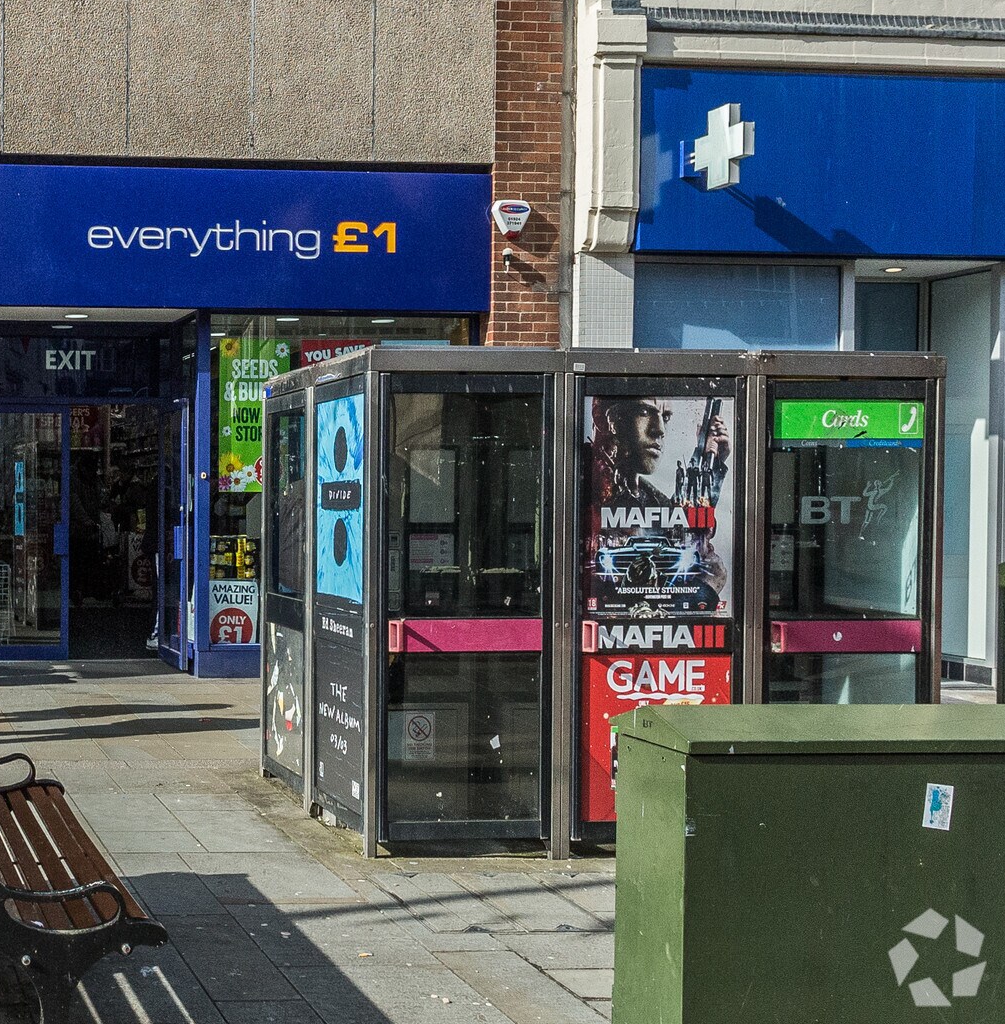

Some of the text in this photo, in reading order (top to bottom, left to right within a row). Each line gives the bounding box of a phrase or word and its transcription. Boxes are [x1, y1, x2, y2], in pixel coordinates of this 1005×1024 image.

[87, 219, 396, 260] everything £1
[46, 350, 96, 370] EXIT
[305, 349, 331, 362] YOU
[232, 359, 278, 378] SEEDS
[224, 382, 236, 402] &
[233, 408, 260, 423] NOW
[822, 409, 869, 428] Cards
[328, 489, 352, 501] DIVIDE
[600, 507, 689, 528] MAFIA
[800, 496, 862, 525] BT
[212, 584, 256, 593] AMAZING
[615, 586, 700, 594] "ABSOLUTELY STUNNING"
[214, 594, 253, 605] VALUE!
[218, 615, 247, 624] ONLY
[329, 618, 354, 638] Sheeran
[218, 626, 244, 644] £1
[599, 625, 695, 649] MAFIA
[606, 659, 706, 693] GAME
[330, 682, 348, 702] THE
[319, 701, 361, 732] NEW ALBUM
[330, 735, 348, 755] 03/03
